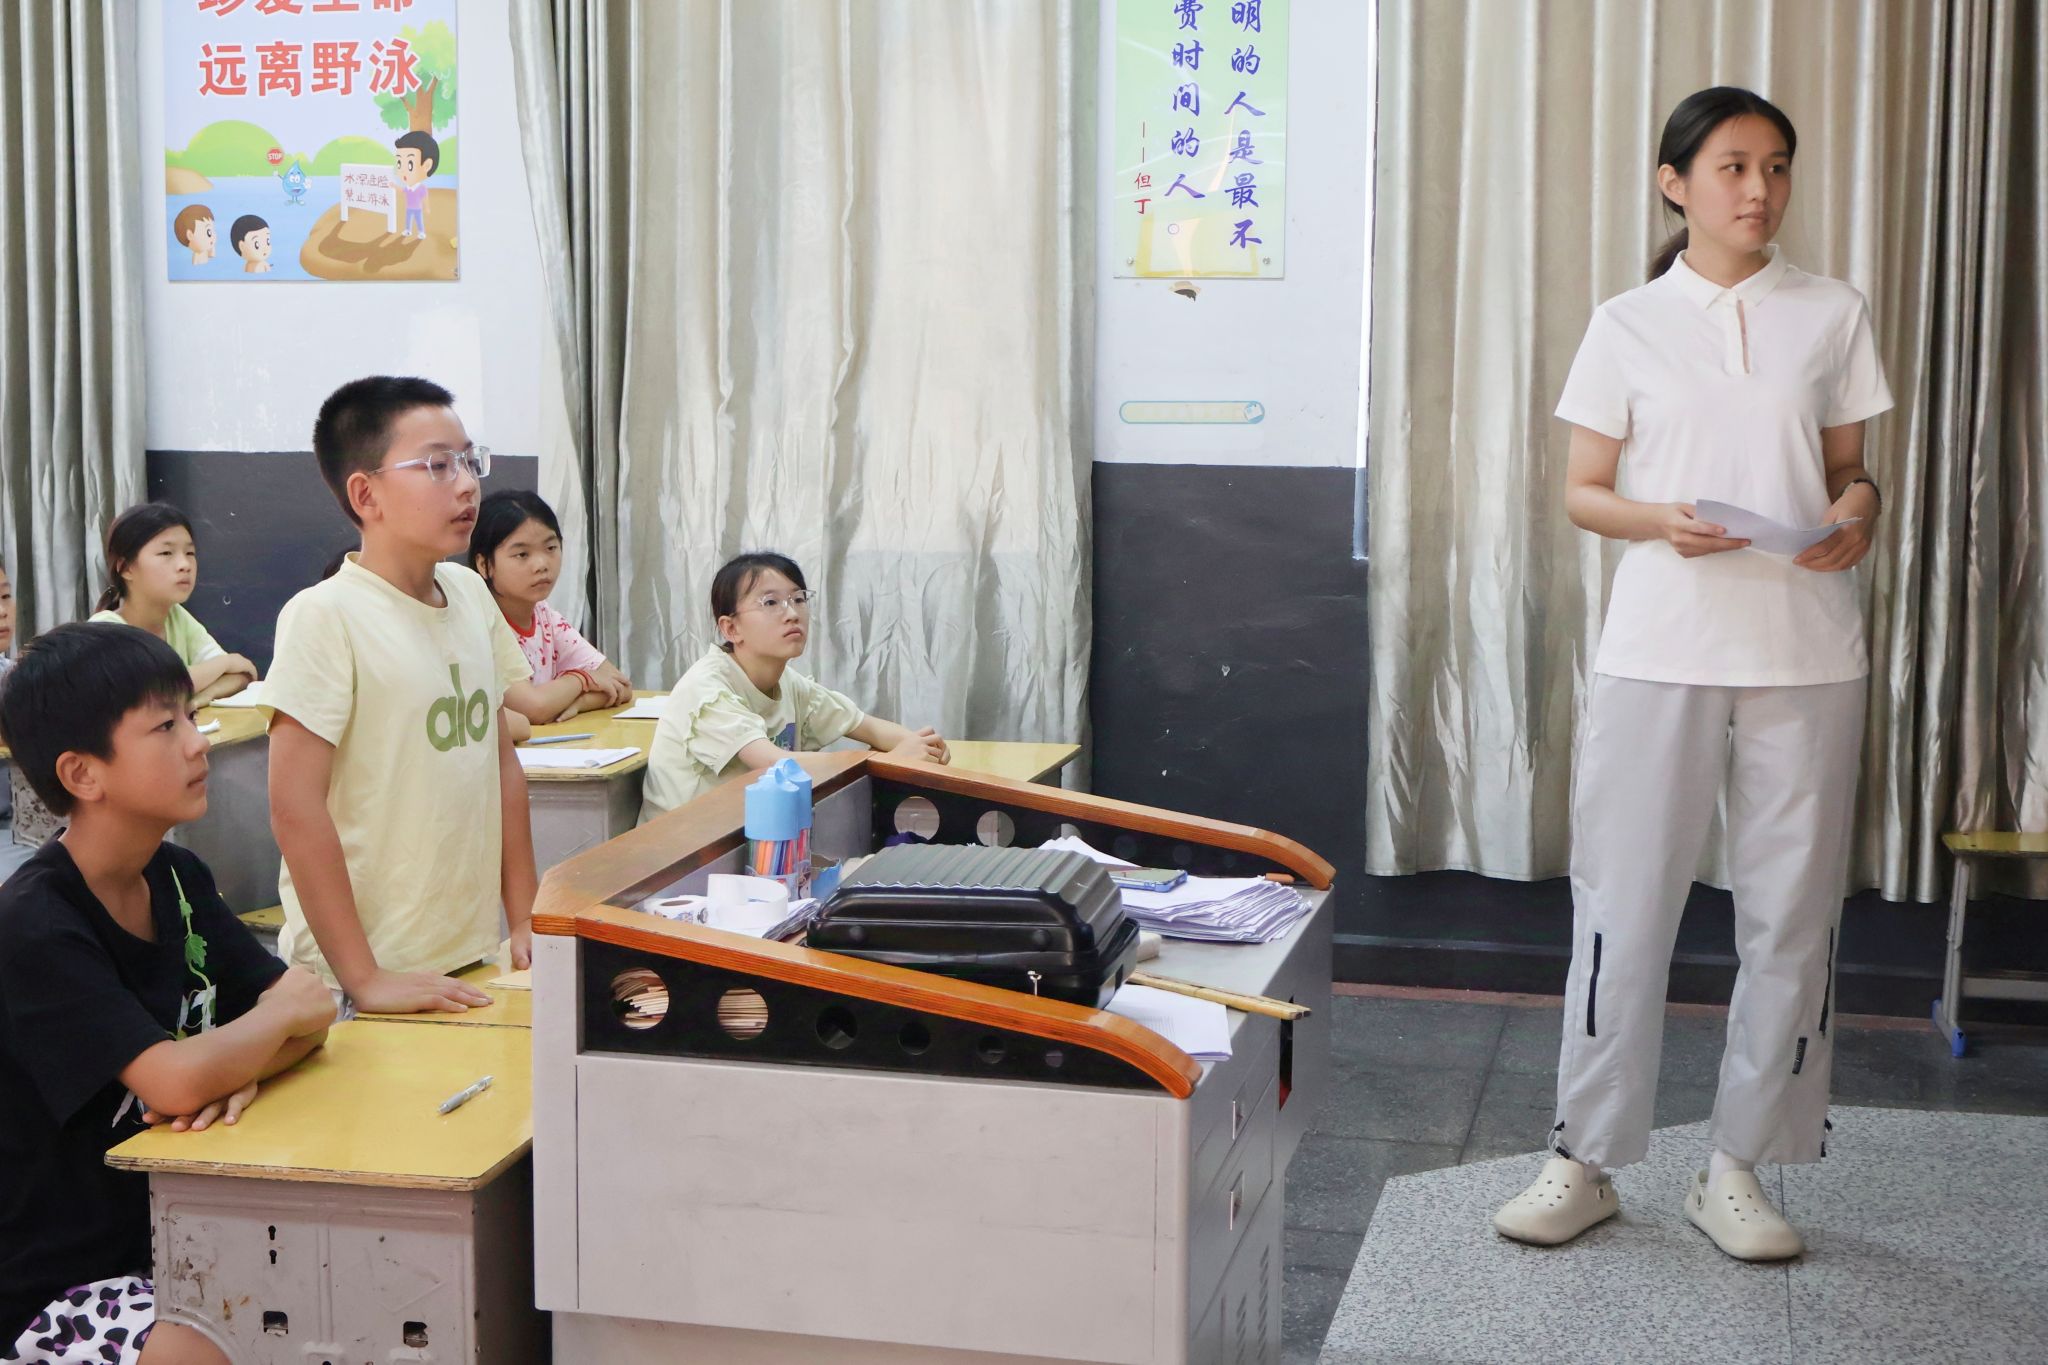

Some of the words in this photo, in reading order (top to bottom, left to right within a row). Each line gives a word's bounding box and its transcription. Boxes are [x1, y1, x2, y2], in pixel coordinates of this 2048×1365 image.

[198, 38, 420, 97] 远离野泳
[1224, 0, 1266, 249] 明的人是最不
[344, 173, 390, 189] 水深危险
[345, 188, 390, 207] 禁止游泳
[426, 663, 490, 752] alo
